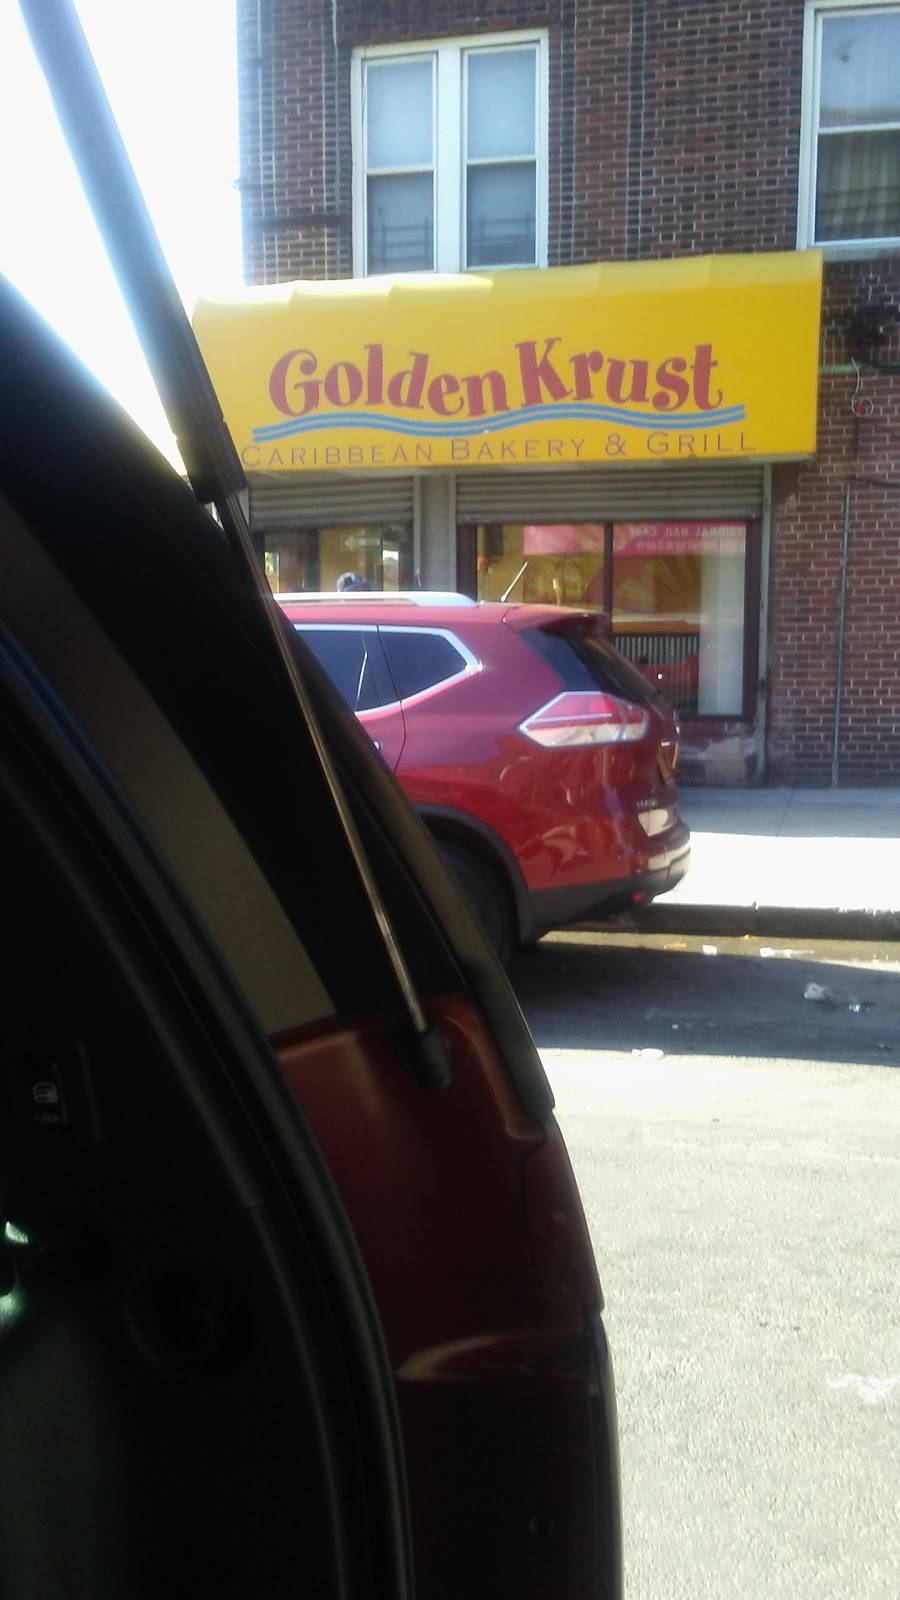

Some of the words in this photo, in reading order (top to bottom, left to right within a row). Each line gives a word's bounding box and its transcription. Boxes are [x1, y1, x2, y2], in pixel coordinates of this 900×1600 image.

[268, 343, 511, 417] Golden
[514, 337, 723, 412] Krust
[240, 443, 433, 468] CARIBBEAN
[450, 438, 586, 462] BAKERY
[604, 432, 627, 456] &
[646, 431, 756, 456] GRILL
